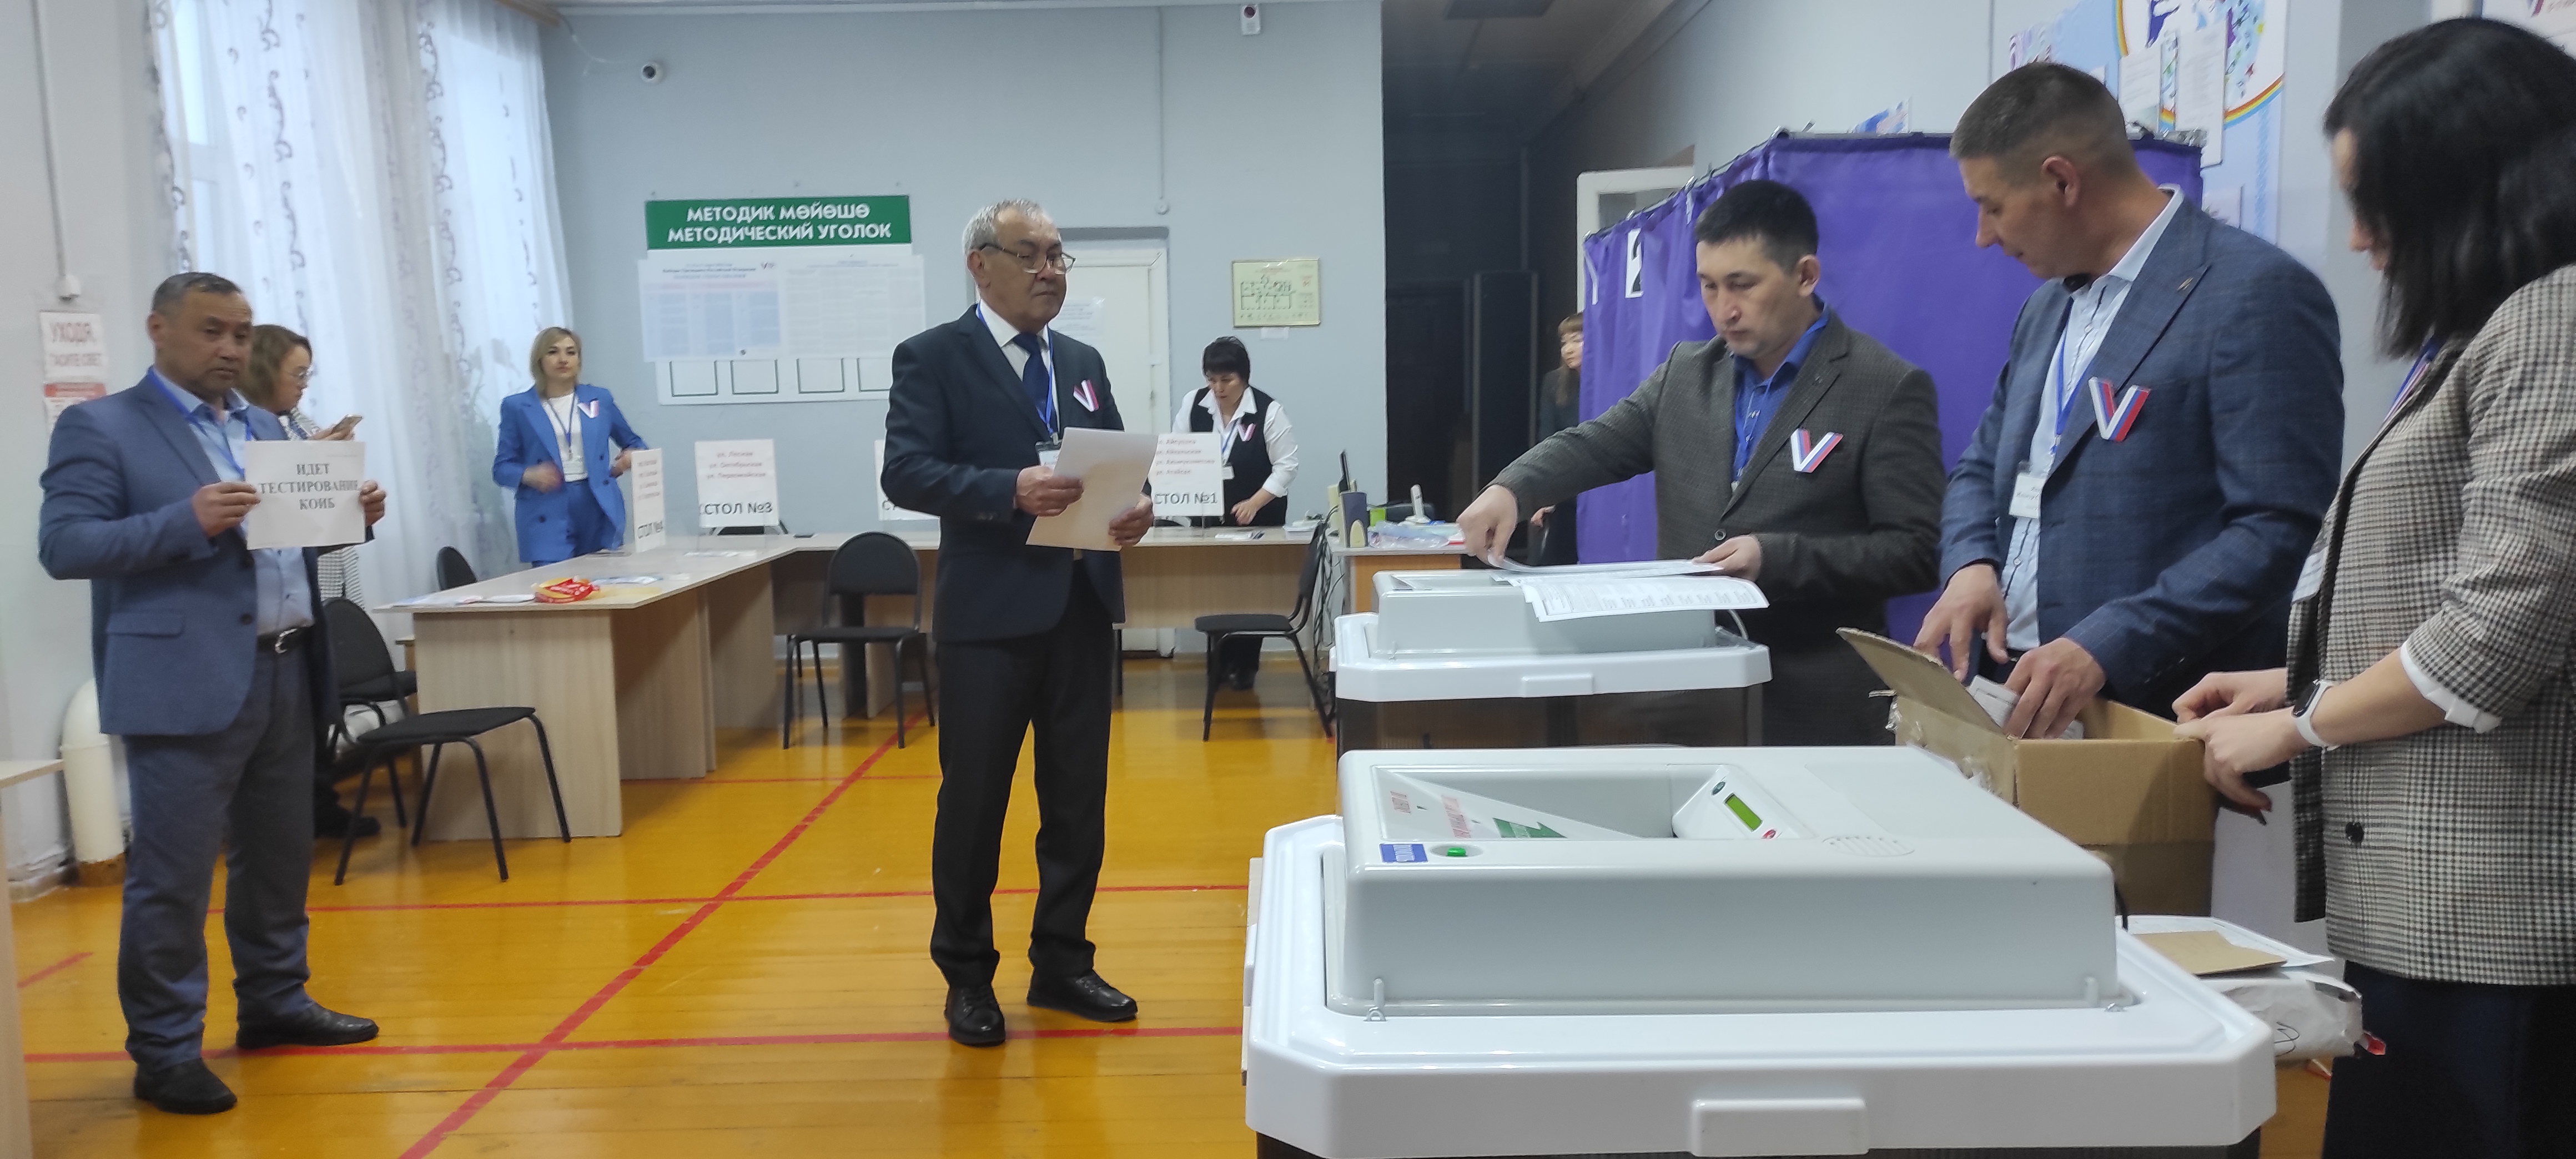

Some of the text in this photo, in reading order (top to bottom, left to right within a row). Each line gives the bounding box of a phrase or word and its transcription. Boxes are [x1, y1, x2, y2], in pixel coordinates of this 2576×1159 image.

[686, 201, 871, 224] МЕТОДИК МӨЙӨШӨ
[667, 222, 892, 244] МЕТОДИЧЕСКИЙ УГОЛОК
[296, 462, 330, 476] ИДЕТ
[299, 497, 335, 510] КОИБ
[1154, 492, 1217, 505] СТОЛ №1
[704, 501, 773, 515] СТОЛ №3
